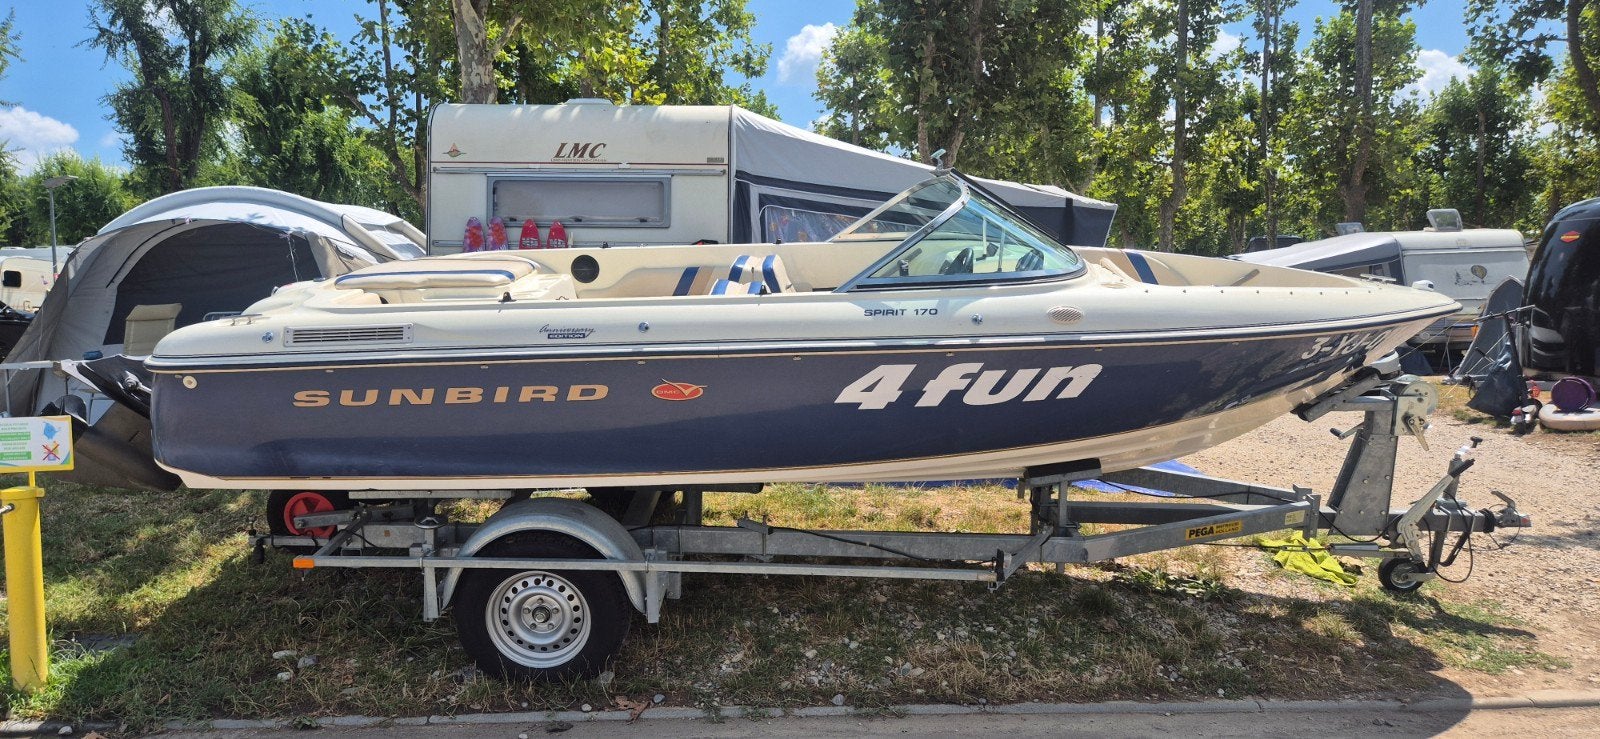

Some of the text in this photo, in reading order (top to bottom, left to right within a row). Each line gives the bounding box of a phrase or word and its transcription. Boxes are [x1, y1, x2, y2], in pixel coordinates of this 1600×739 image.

[552, 142, 608, 159] LMC
[863, 307, 939, 317] SPIRIT 170
[538, 323, 596, 338] Anniversary
[834, 362, 1104, 410] 4 fun
[292, 384, 610, 409] SUNBIRD
[1188, 525, 1215, 538] PEGA
